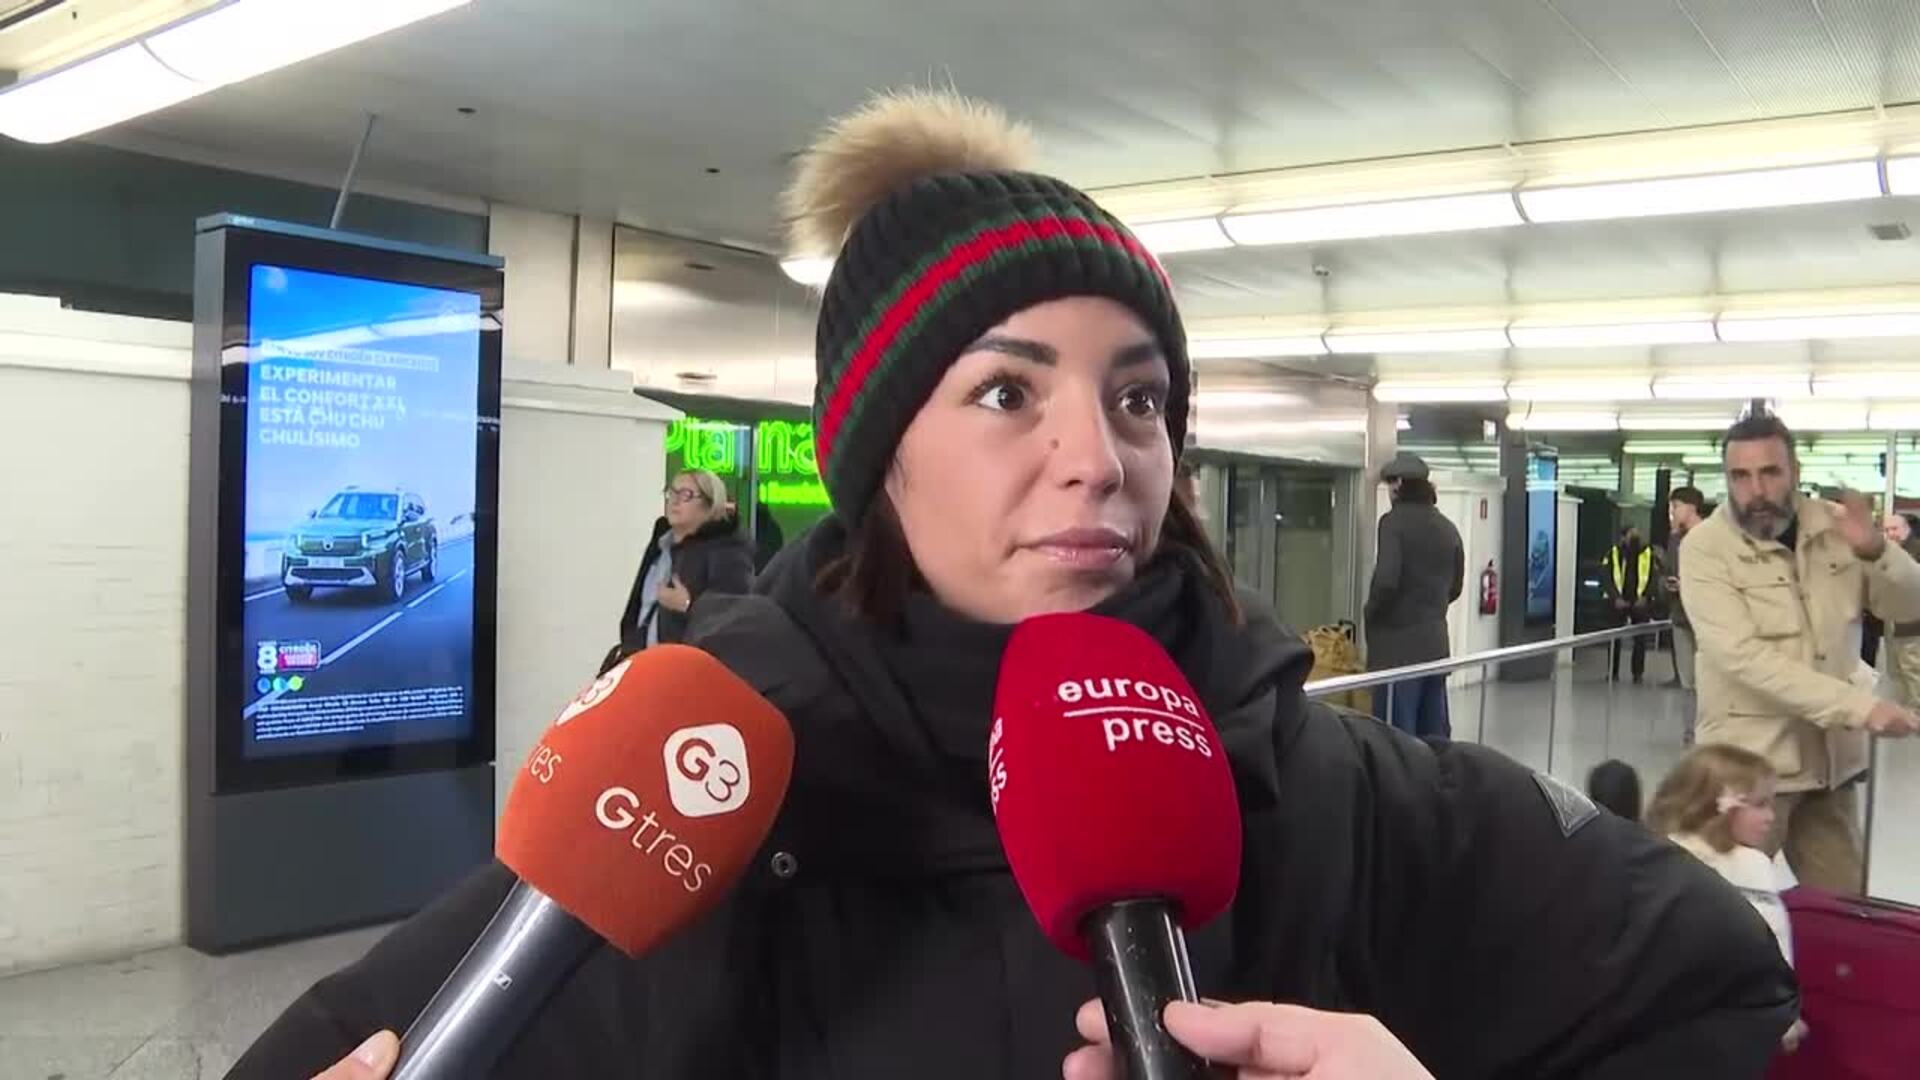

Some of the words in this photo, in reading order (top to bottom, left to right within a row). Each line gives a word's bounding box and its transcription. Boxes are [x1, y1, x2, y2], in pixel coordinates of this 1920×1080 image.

[260, 365, 397, 390] EXPERIMENTAR
[260, 386, 281, 402] EL
[284, 388, 368, 410] CONFORT
[309, 407, 347, 428] CHU
[349, 412, 385, 430] CHU
[259, 429, 361, 447] CHULÍSIMO
[257, 645, 277, 669] 8
[1058, 678, 1200, 718] europa
[1103, 717, 1212, 757] press
[676, 737, 741, 803] G3
[594, 786, 712, 892] Gtres
